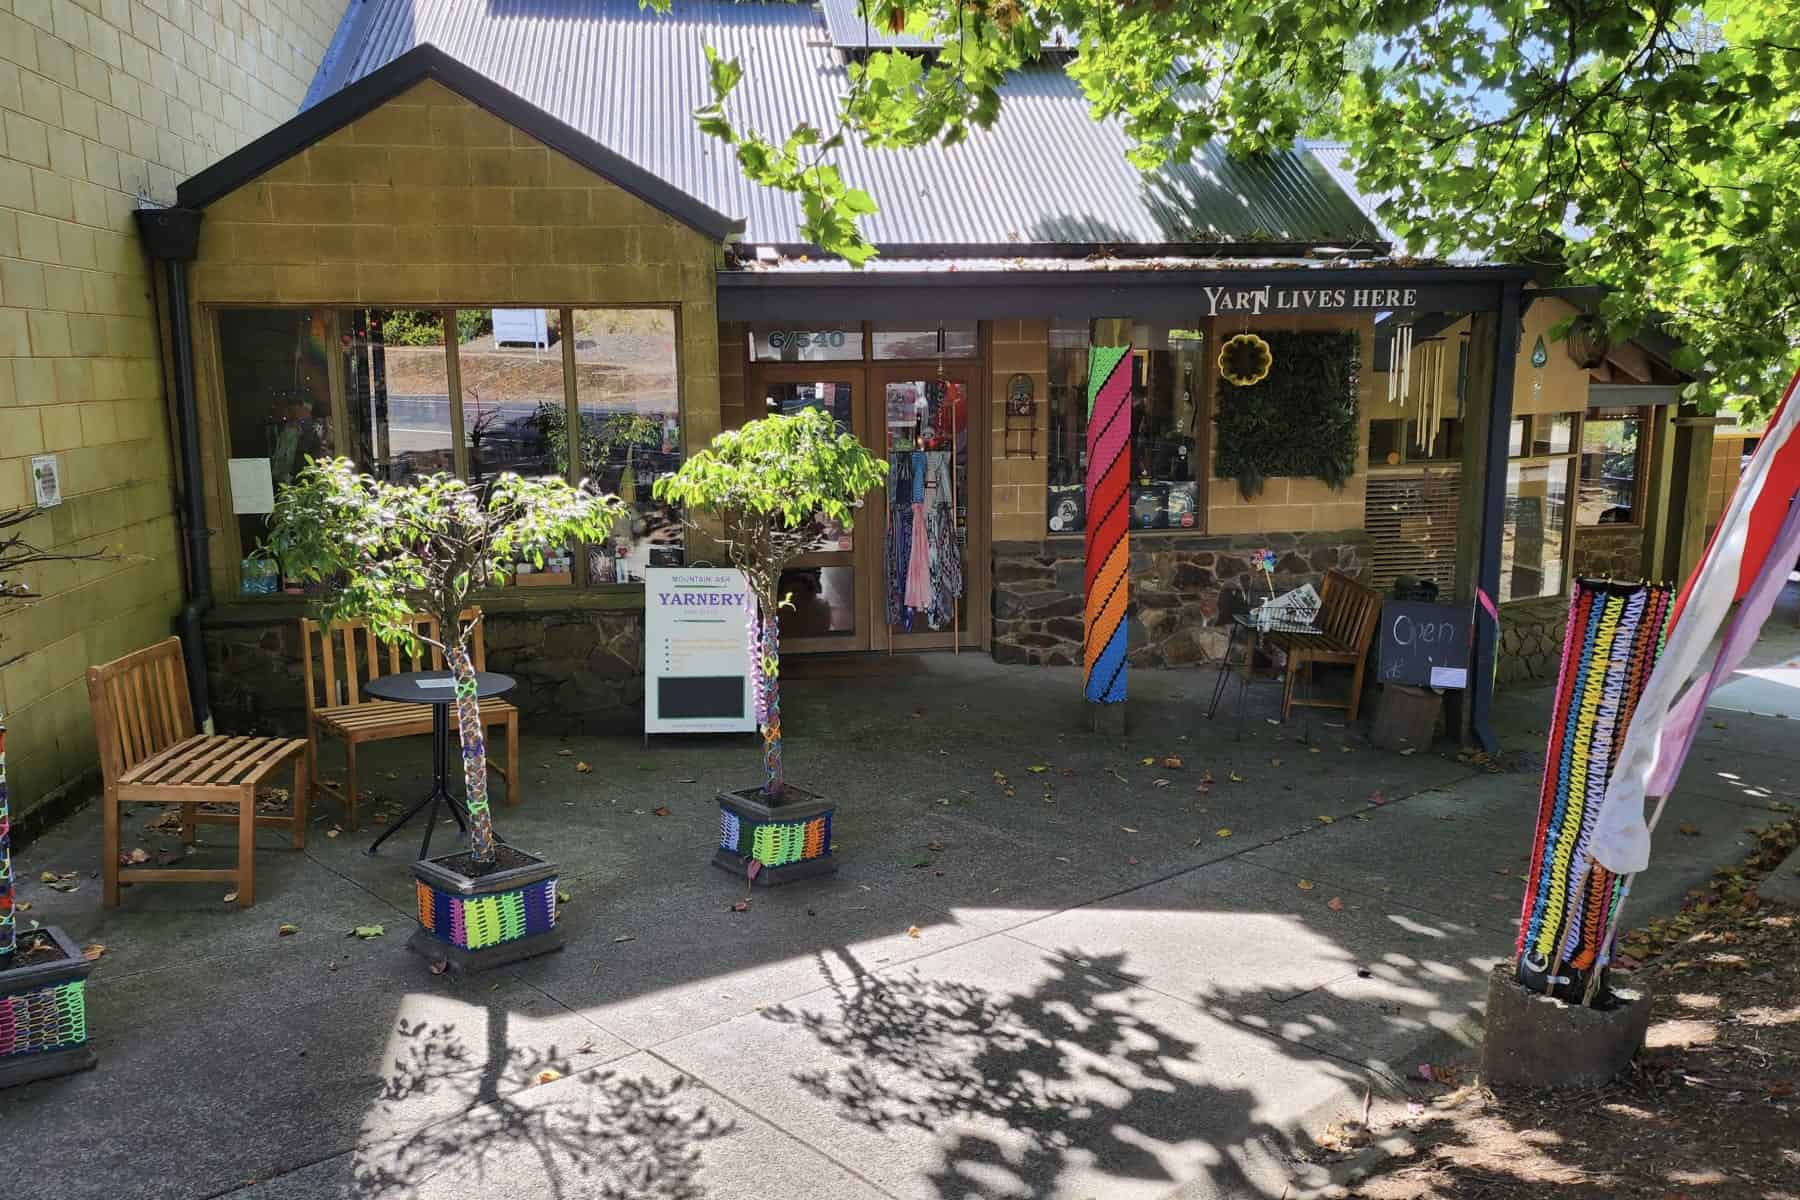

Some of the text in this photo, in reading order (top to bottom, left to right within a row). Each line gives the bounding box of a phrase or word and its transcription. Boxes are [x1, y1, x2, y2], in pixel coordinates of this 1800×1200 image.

[1277, 289, 1345, 309] LIVES
[1352, 289, 1417, 307] HERE
[768, 331, 845, 350] 6/540
[659, 593, 745, 606] YARNERY
[1393, 615, 1455, 656] Open
